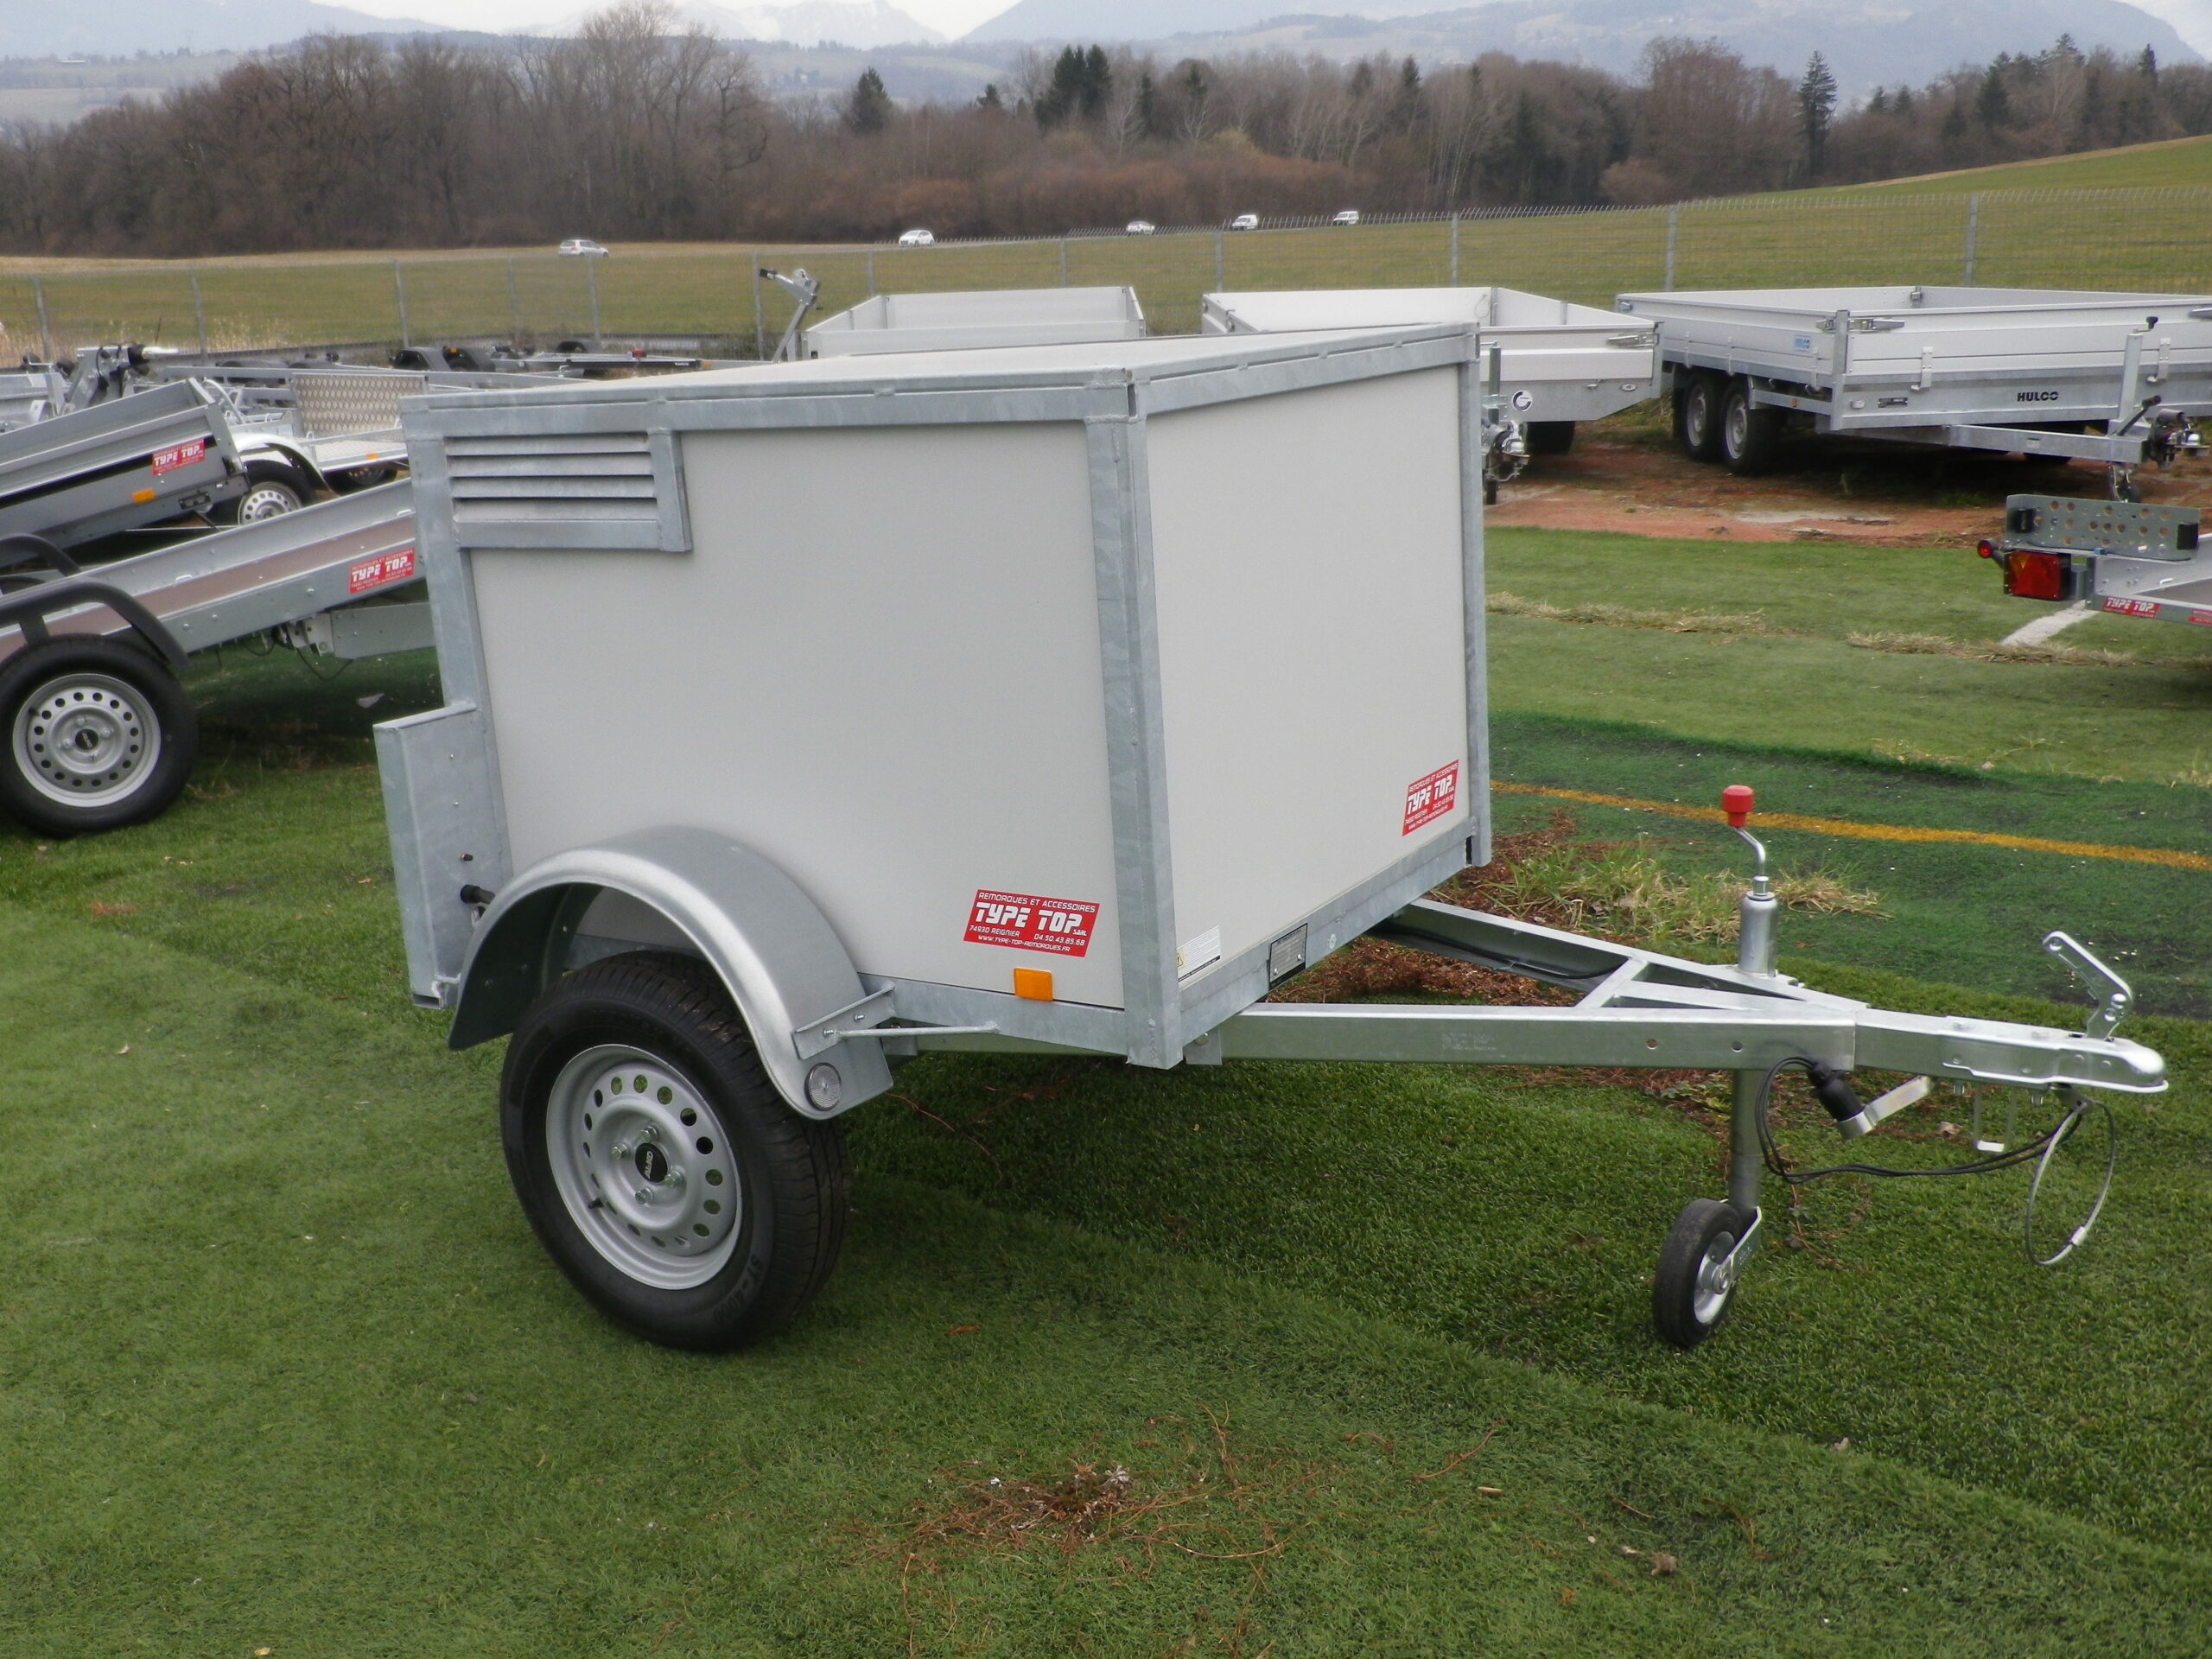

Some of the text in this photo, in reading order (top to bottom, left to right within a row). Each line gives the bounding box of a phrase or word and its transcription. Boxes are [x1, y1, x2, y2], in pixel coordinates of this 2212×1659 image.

[2017, 391, 2059, 402] HULCO
[154, 451, 178, 467] TYPE
[181, 445, 200, 458] TOP
[352, 563, 381, 582] TYPE
[385, 556, 408, 573] TOP
[2106, 597, 2133, 610] TYPE
[2133, 601, 2155, 613] TOP
[1407, 785, 1432, 815] TYPE
[1433, 774, 1453, 800] TOP
[978, 892, 1028, 905] REMORQUES
[1042, 899, 1096, 912] ACCESSOIRES
[976, 901, 1032, 928] TYPE
[1038, 909, 1083, 934] TOP
[969, 925, 1085, 946] 74930 REIGNIER 04.50.43.85.68
[978, 935, 1071, 951] WWW.TYPE-TOP-REMORQUES.FR
